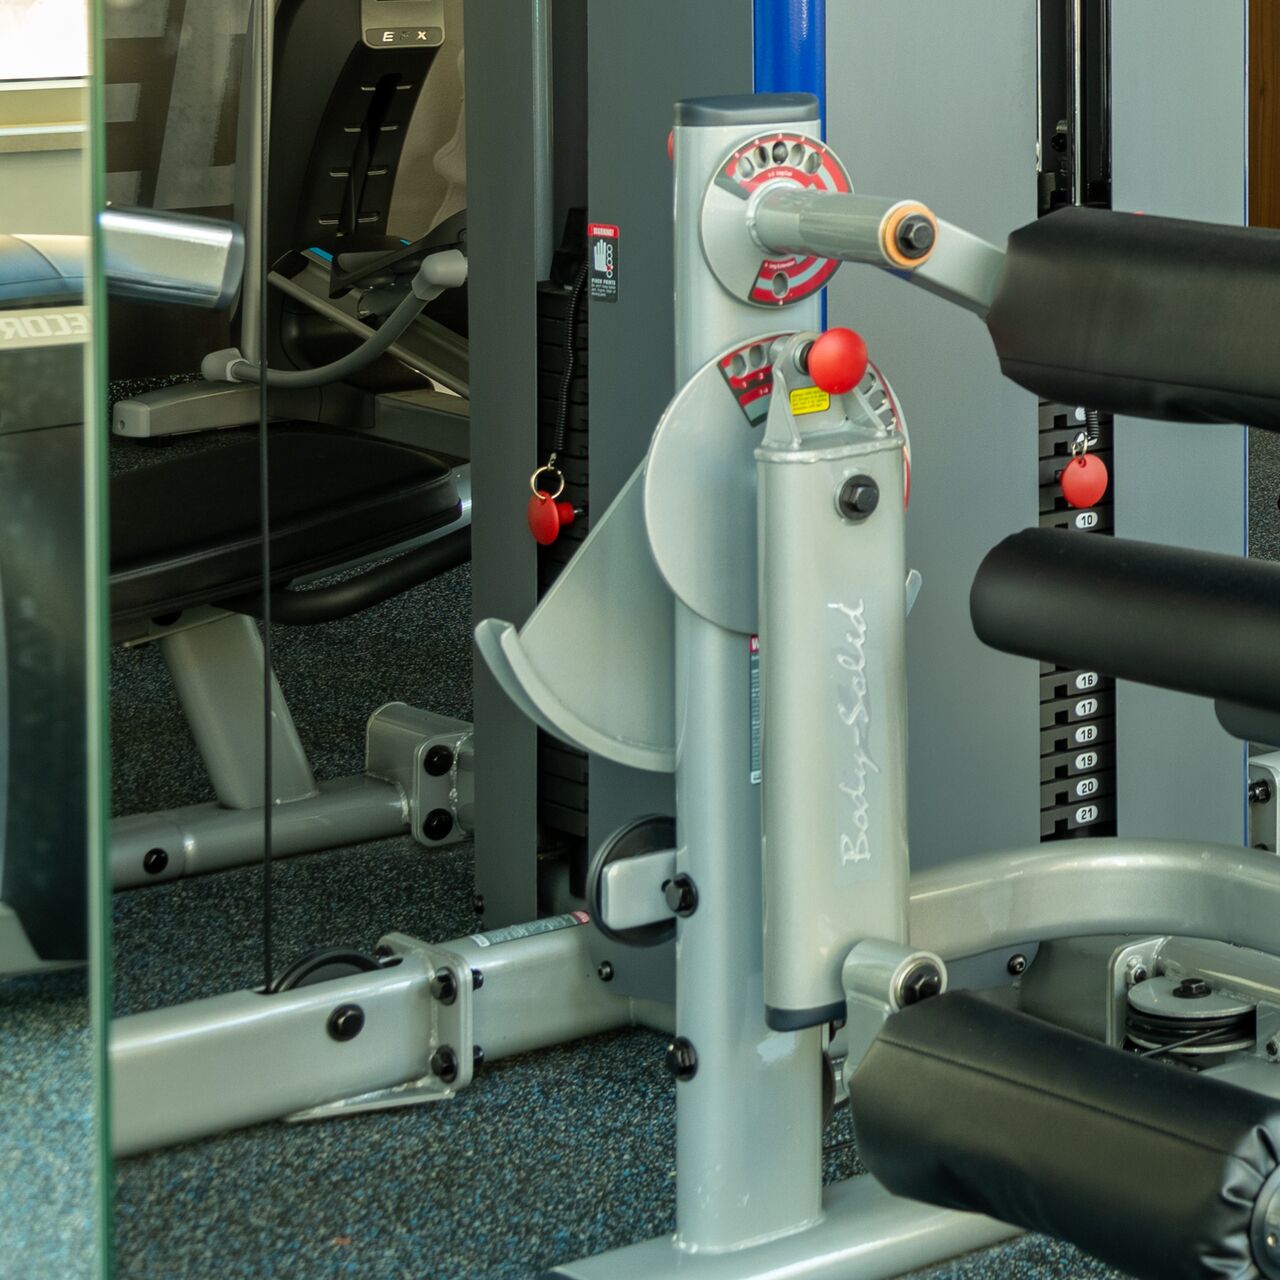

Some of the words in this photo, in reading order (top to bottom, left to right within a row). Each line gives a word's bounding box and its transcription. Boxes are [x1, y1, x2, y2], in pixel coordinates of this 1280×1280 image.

[382, 31, 427, 42] EX
[1081, 515, 1093, 526] 10
[1082, 674, 1094, 687] 16
[1081, 701, 1093, 714] 17
[1081, 728, 1093, 740] 18
[1081, 755, 1093, 767] 19
[1082, 781, 1094, 794] 20
[1081, 807, 1093, 820] 21
